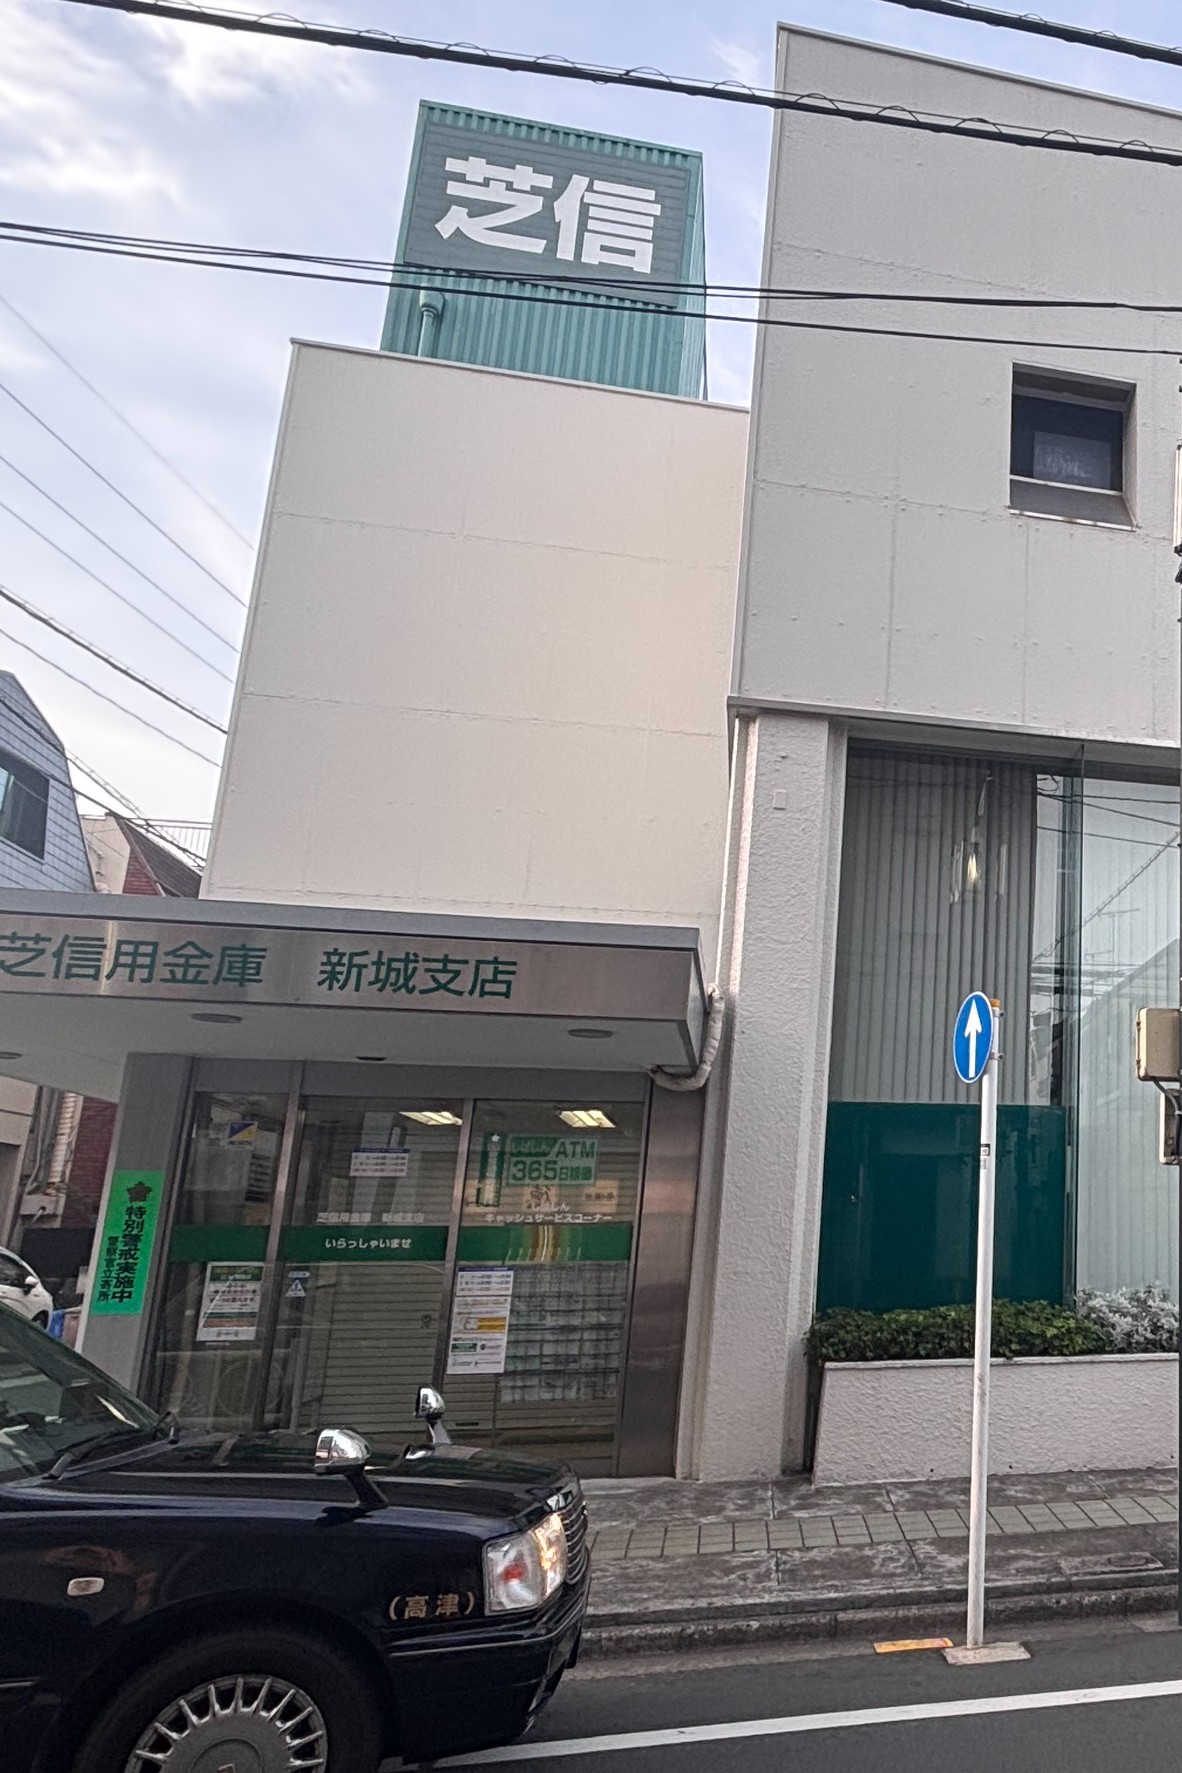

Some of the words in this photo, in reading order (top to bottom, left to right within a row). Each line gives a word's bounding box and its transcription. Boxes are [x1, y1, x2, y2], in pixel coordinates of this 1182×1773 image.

[434, 156, 661, 273] 芝信
[0, 932, 268, 987] 芝信用金庫
[317, 946, 518, 999] 新城支店
[555, 1140, 596, 1159] ATM
[484, 1213, 613, 1223] キャッシュサービスコーナー
[112, 1205, 147, 1303] 特別警戒実施中
[325, 1238, 412, 1249] いらっしゃいませ
